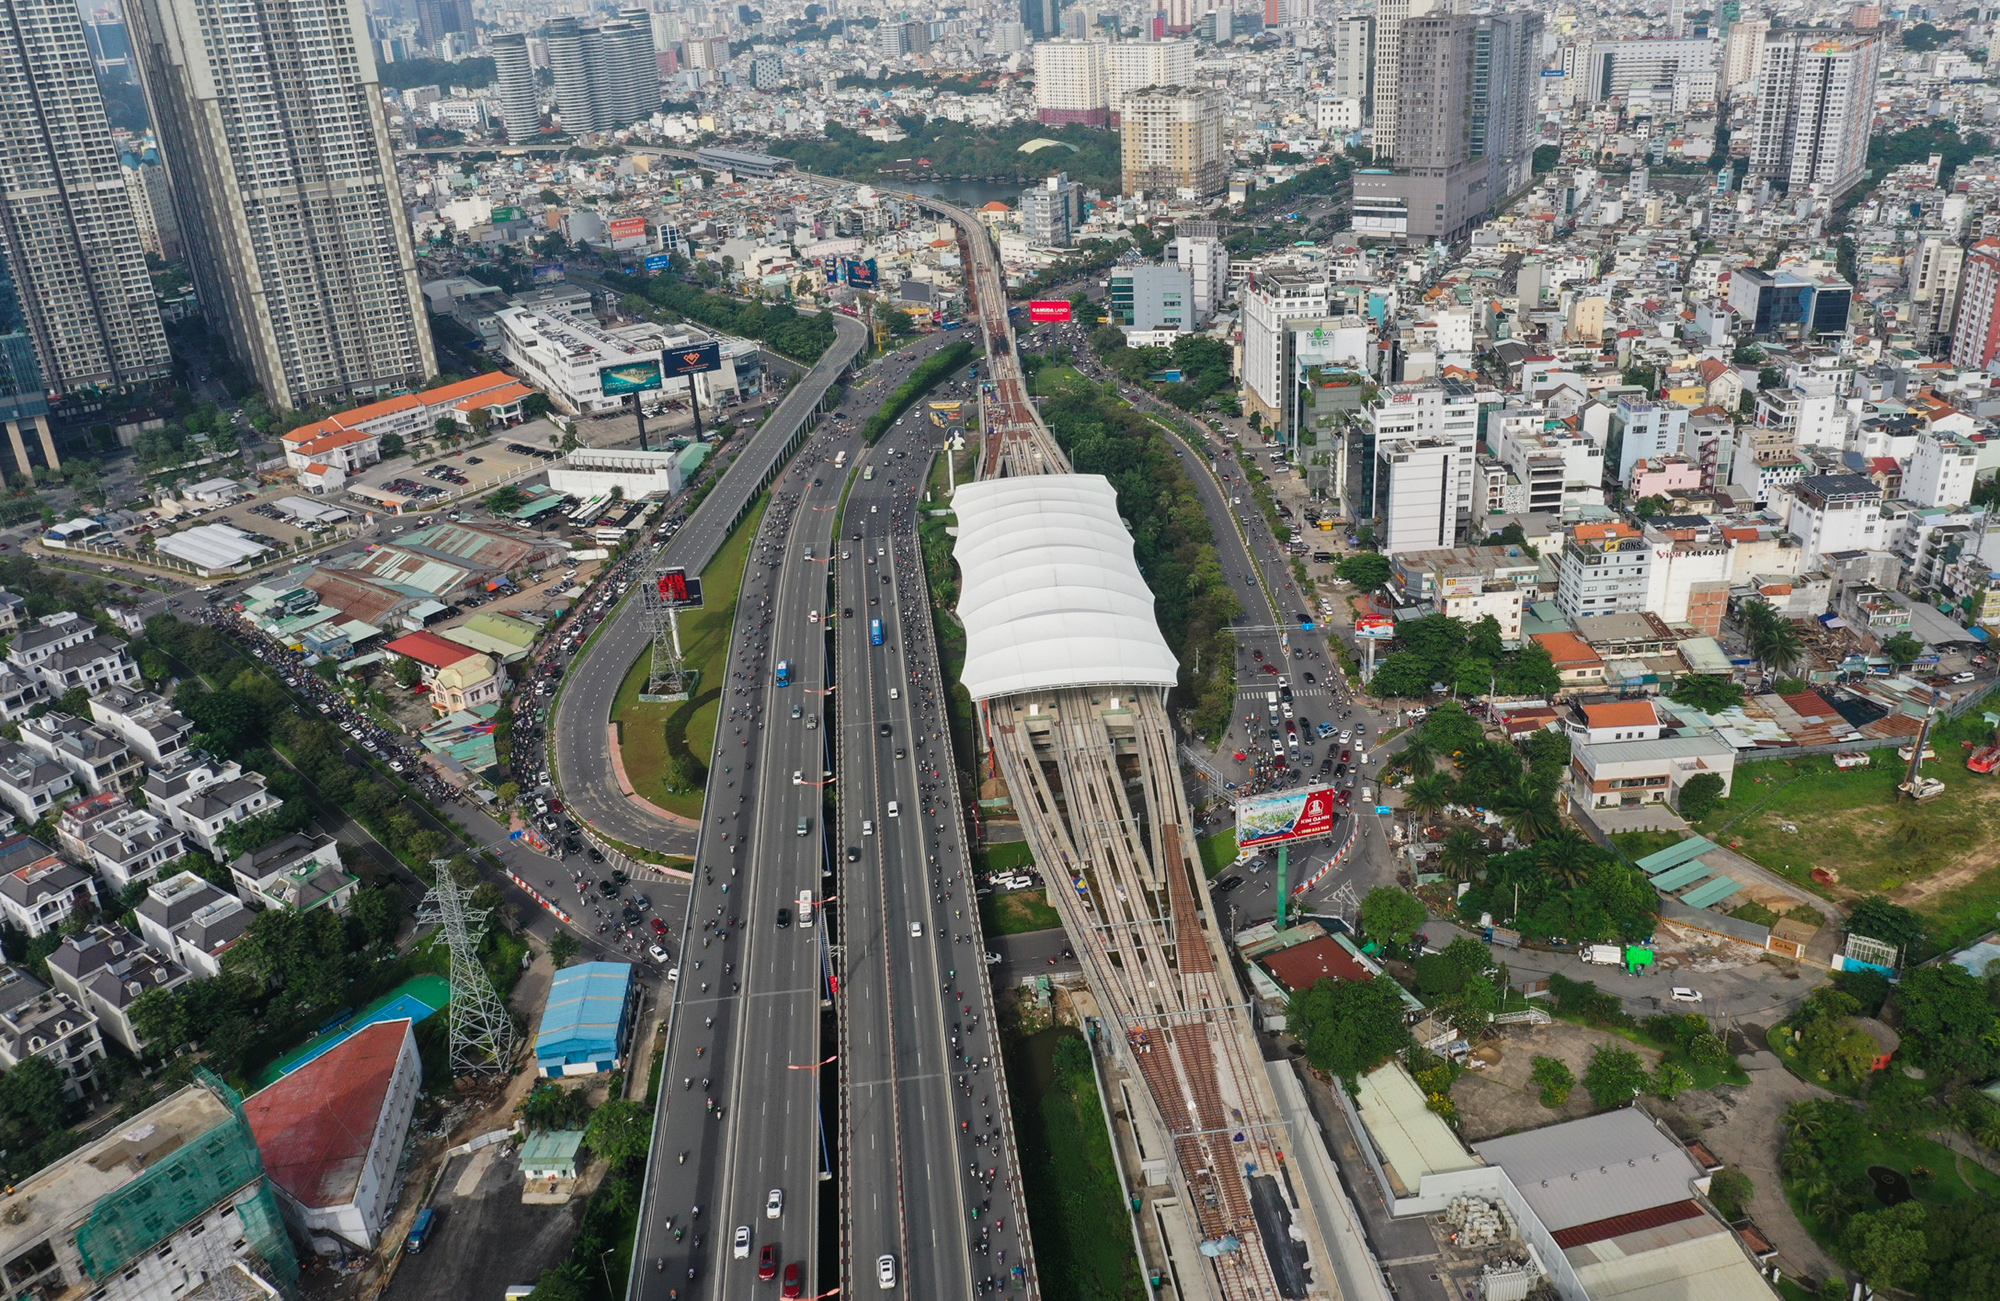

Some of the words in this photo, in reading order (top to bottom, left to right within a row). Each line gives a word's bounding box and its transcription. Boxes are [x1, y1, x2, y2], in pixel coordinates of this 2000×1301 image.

[1393, 393, 1413, 403] EBM
[1619, 540, 1642, 551] CONS
[1312, 814, 1330, 822] OANH
